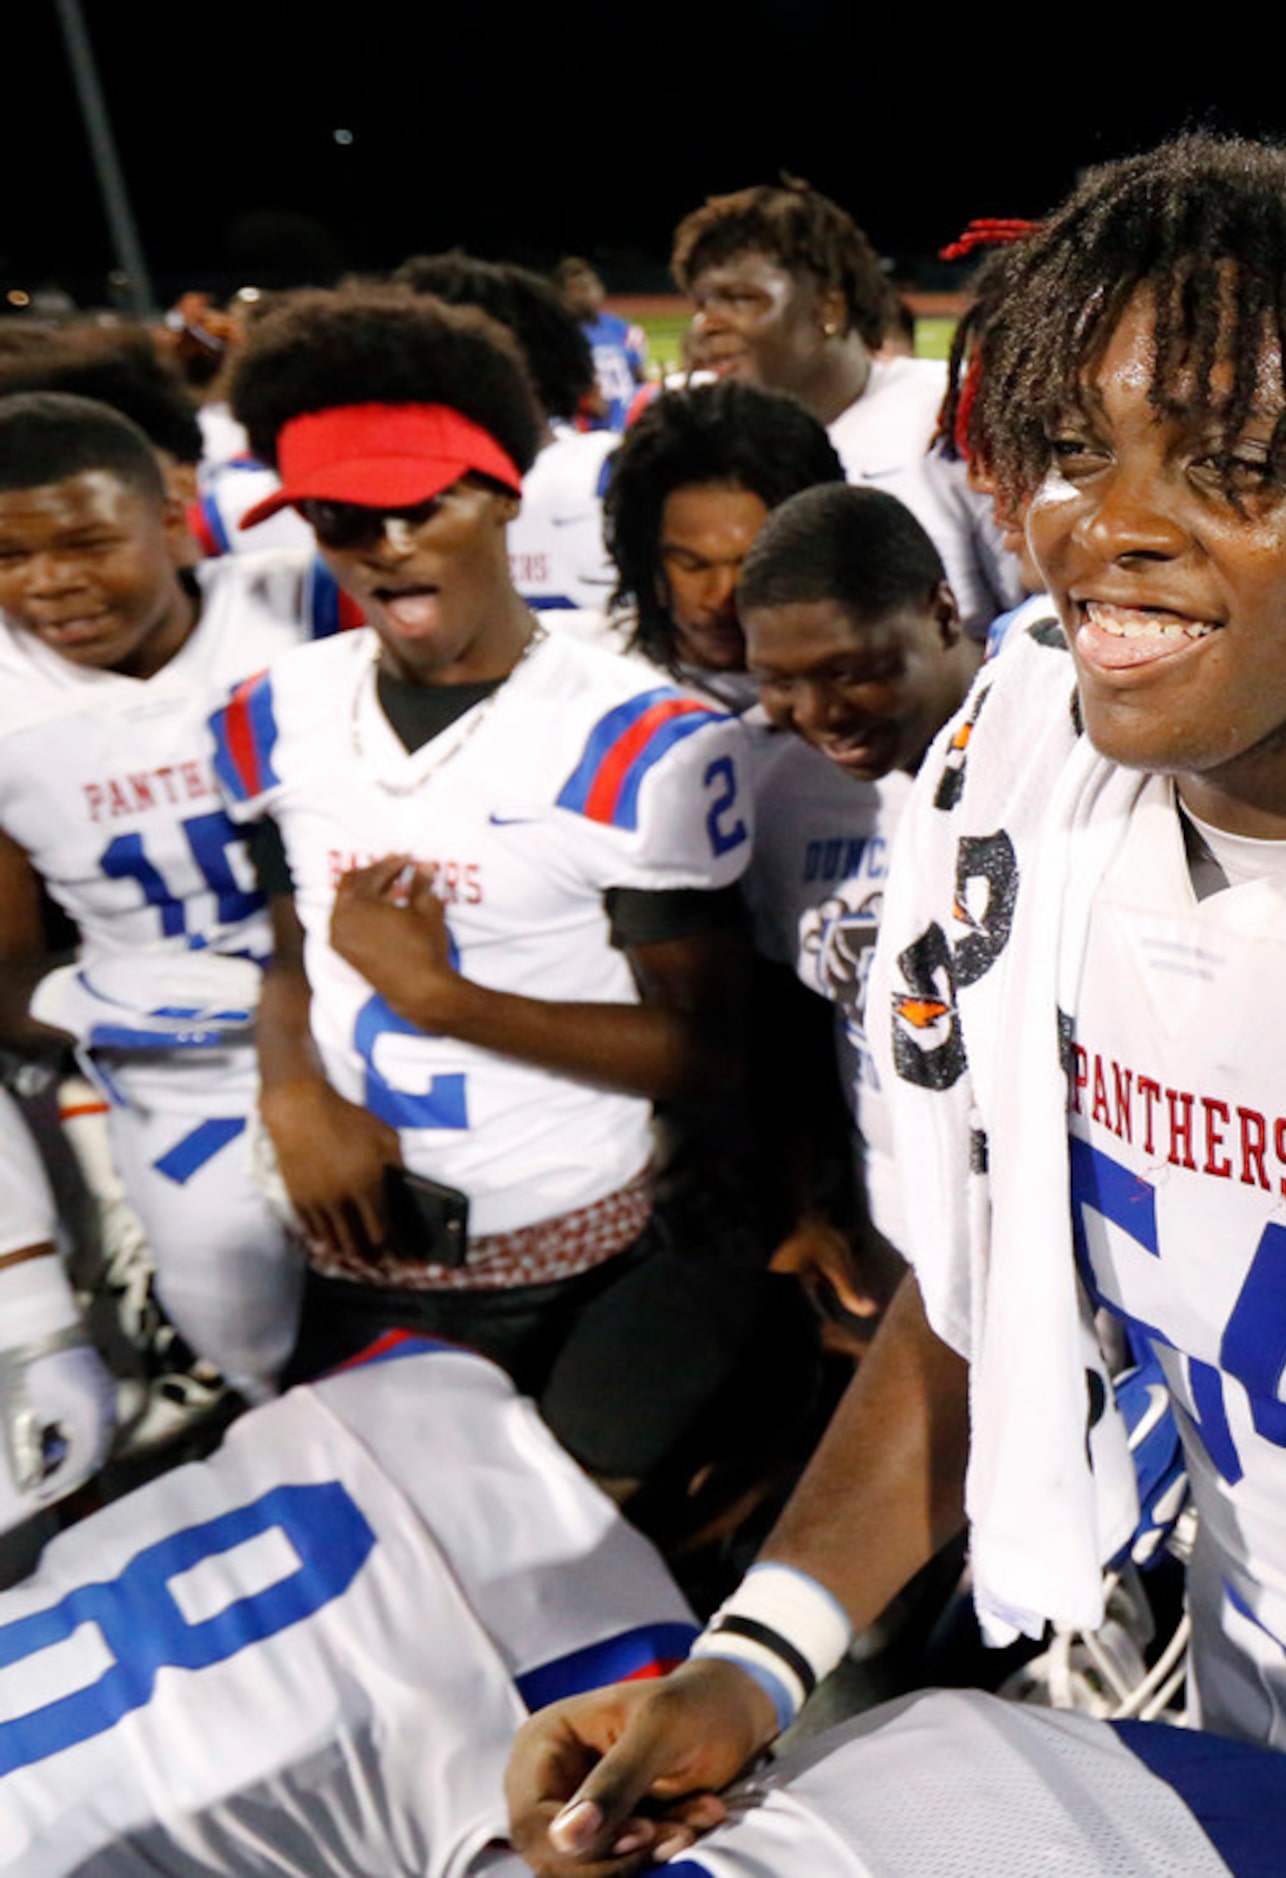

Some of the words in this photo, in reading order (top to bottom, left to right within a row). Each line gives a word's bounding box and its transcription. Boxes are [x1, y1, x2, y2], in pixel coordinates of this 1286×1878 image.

[83, 760, 222, 823] PANTH
[704, 755, 747, 859] 2
[803, 837, 888, 882] DUNC
